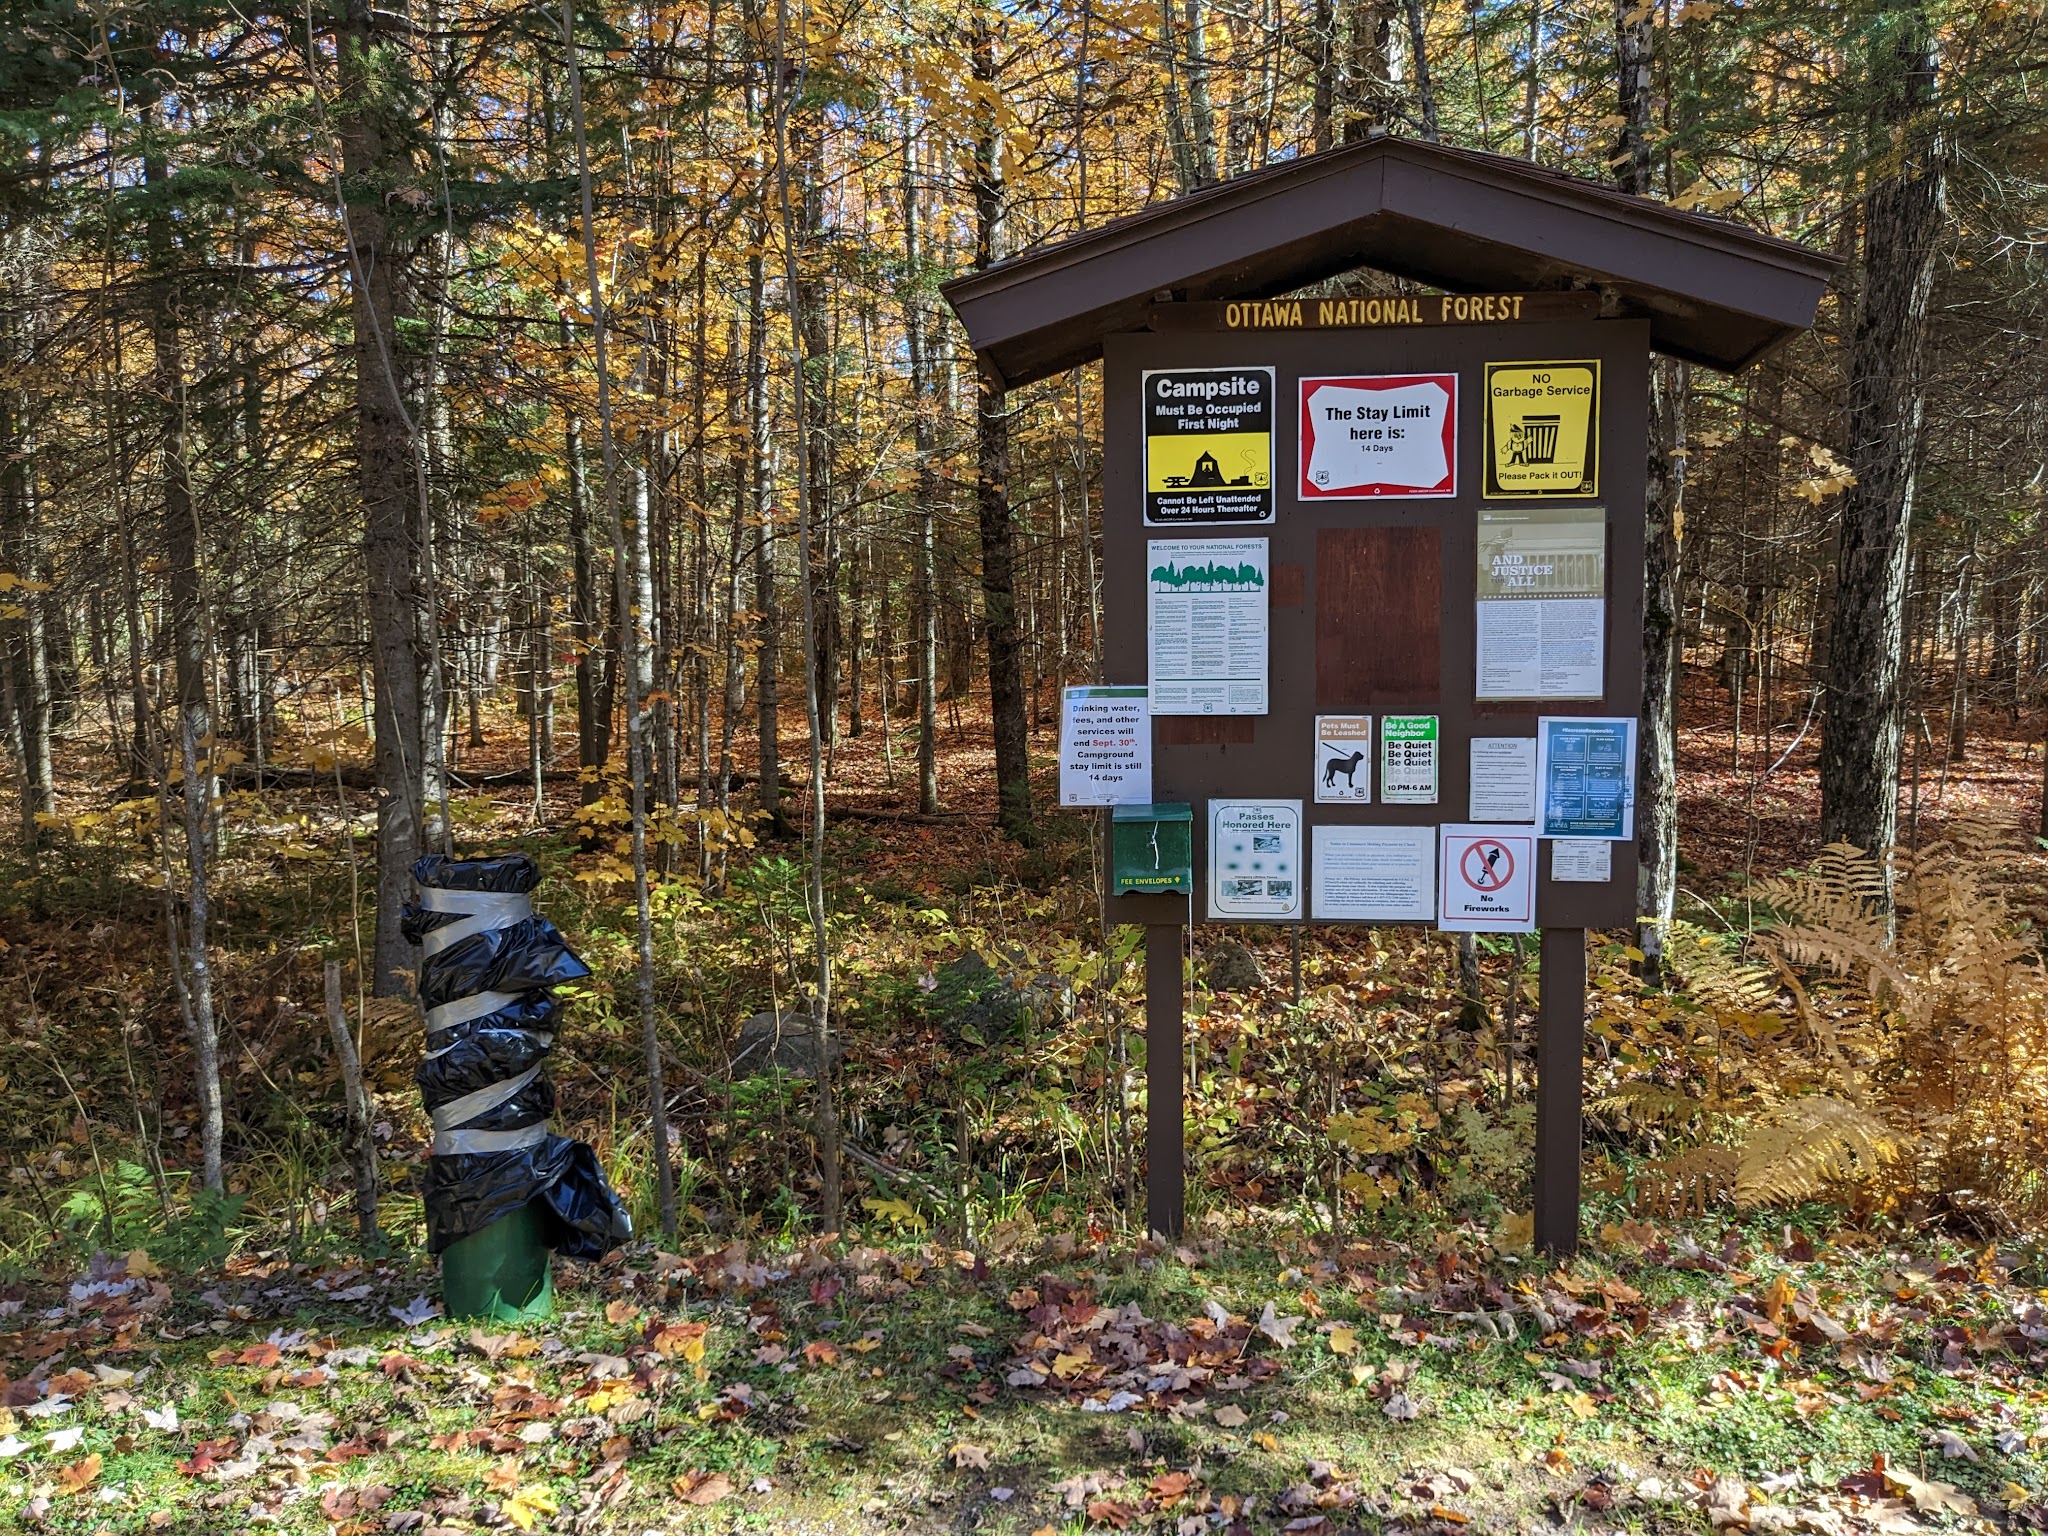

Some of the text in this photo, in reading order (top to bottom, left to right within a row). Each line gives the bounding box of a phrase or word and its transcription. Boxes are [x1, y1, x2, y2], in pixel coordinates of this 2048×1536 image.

[1226, 296, 1524, 328] OTTAWA NATIONAL FOREST
[1532, 374, 1550, 384] NO
[1156, 376, 1260, 401] Campsite
[1494, 386, 1590, 398] Garbage Service
[1156, 402, 1261, 416] Must Be Occupied
[1326, 405, 1430, 422] The Stay Limit
[1178, 418, 1239, 431] First Night
[1350, 426, 1405, 440] here is:
[1373, 444, 1394, 453] Days
[1498, 472, 1527, 480] Please
[1530, 472, 1550, 480] Pack
[1560, 471, 1582, 479] OUT!
[1157, 494, 1261, 505] Cannot Be Left Unattended
[1160, 504, 1258, 514] Over 24 Hours Thereafter
[1492, 555, 1523, 565] AND
[1491, 565, 1553, 576] JUSTICE
[1507, 576, 1535, 587] ALL
[1073, 704, 1108, 713] Drinking
[1112, 705, 1140, 713] water,
[1072, 716, 1094, 724] fees,
[1386, 722, 1430, 730] Be A Good
[1078, 728, 1115, 736] services
[1386, 730, 1425, 738] Neighbor
[1092, 740, 1116, 748] Sept.
[1388, 742, 1432, 750] Be Quiet
[1078, 751, 1134, 759] Campground
[1388, 750, 1432, 758] Be Quiet
[1092, 762, 1112, 770] limit
[1114, 762, 1122, 770] is
[1124, 762, 1142, 770] still
[1388, 759, 1432, 767] Be Quiet
[1089, 774, 1123, 782] 14 days
[1222, 820, 1291, 829] Honored Here
